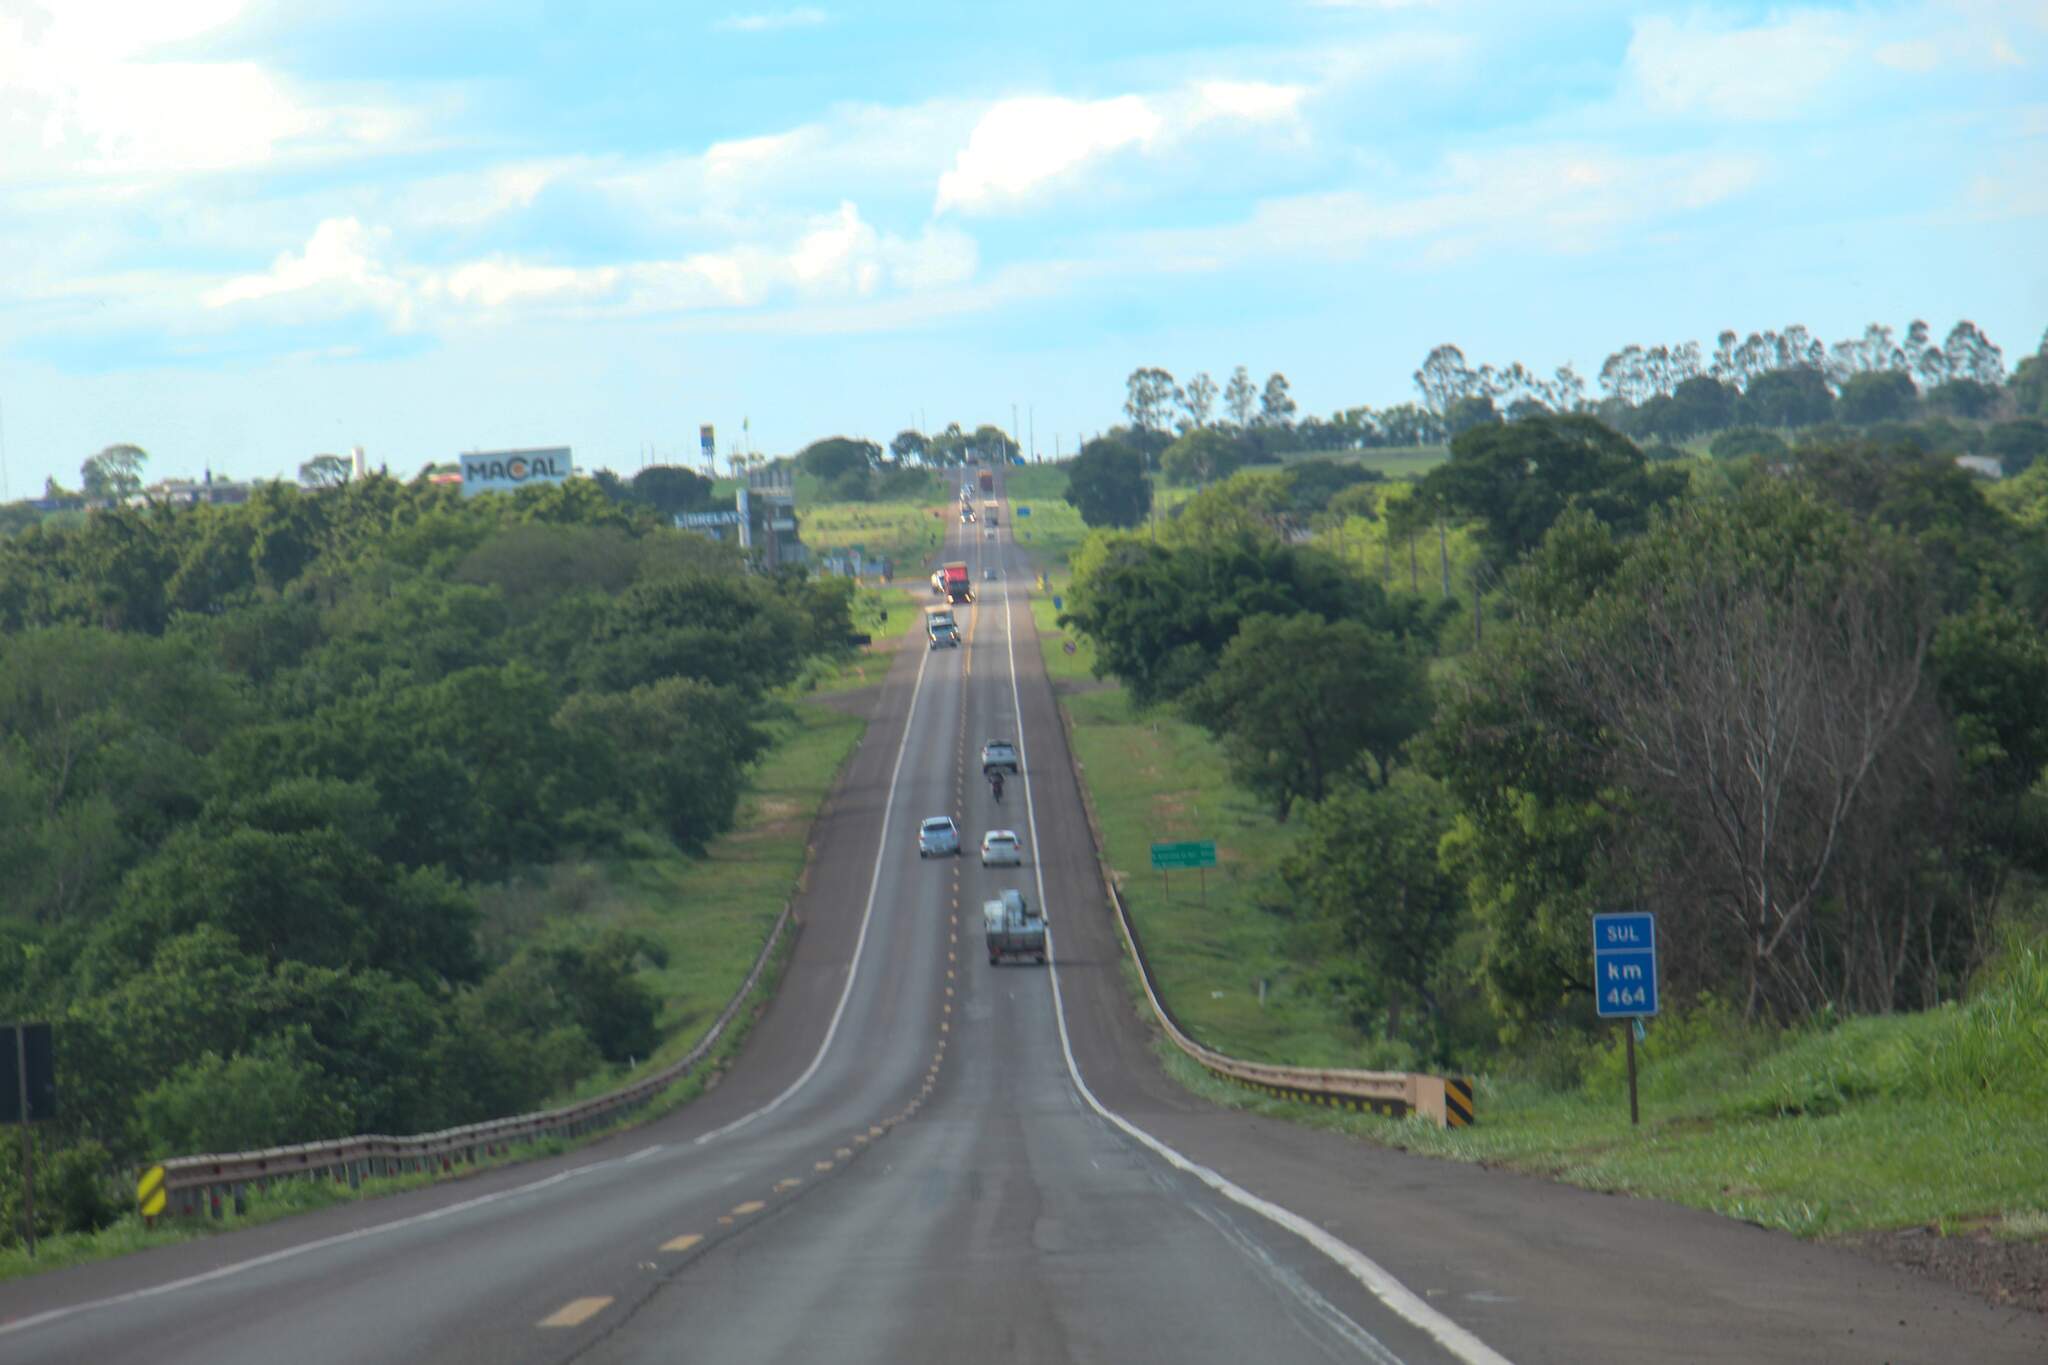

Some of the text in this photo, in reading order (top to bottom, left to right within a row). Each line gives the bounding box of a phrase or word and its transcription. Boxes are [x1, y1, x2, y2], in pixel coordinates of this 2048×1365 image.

[466, 456, 566, 482] MACAL
[1607, 926, 1640, 942] SUL
[1608, 961, 1642, 980] km
[1607, 986, 1645, 1006] 464
